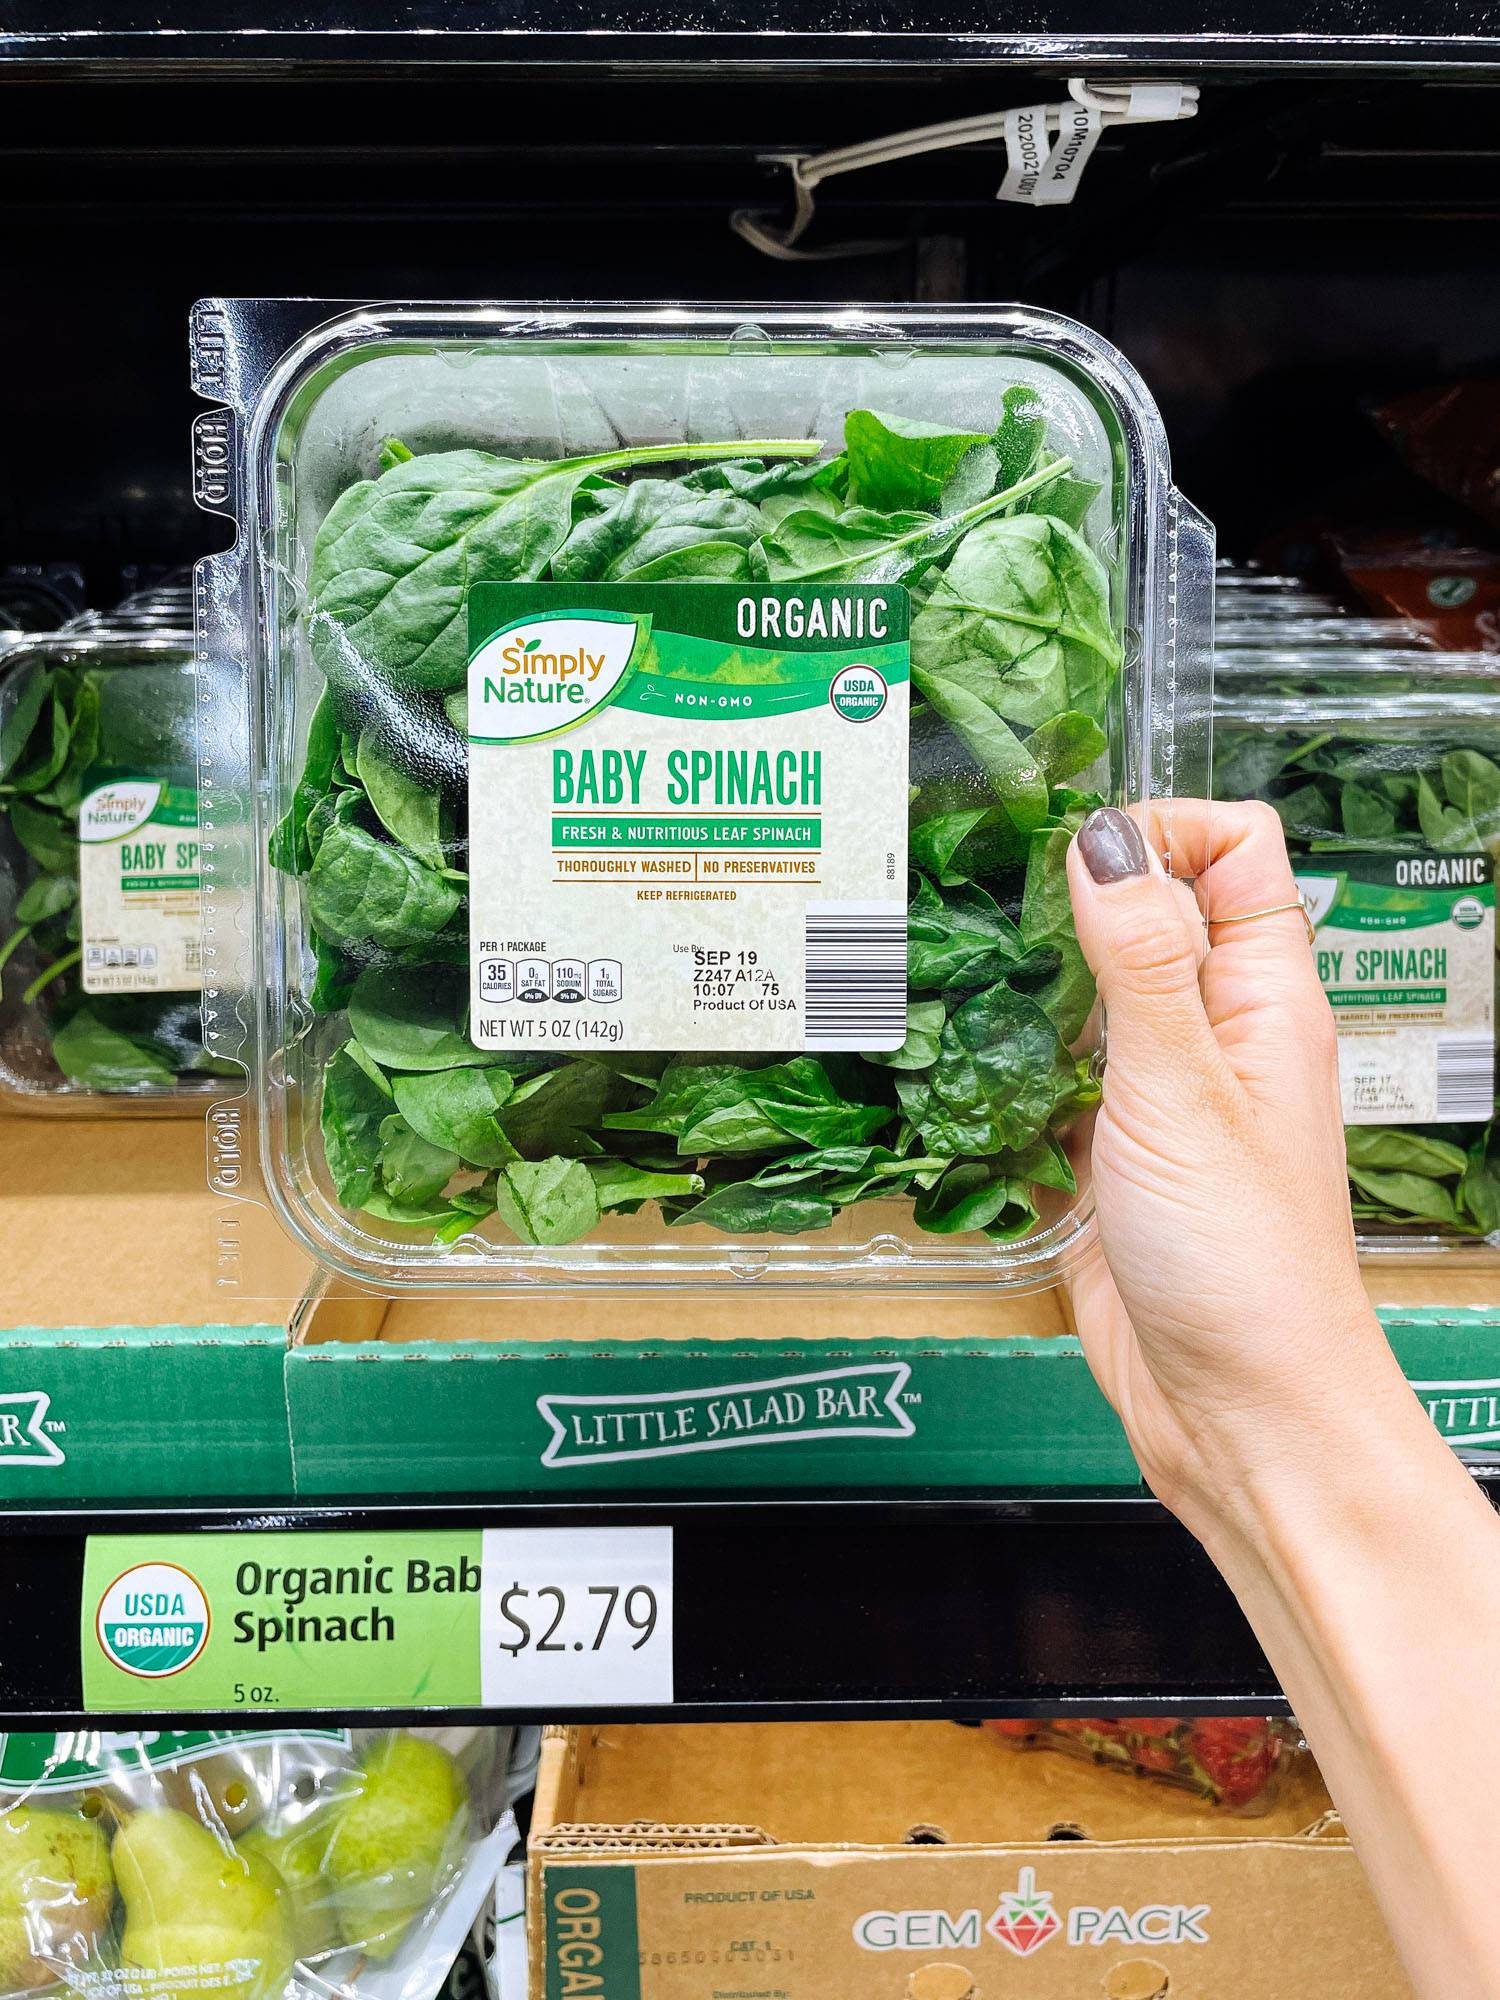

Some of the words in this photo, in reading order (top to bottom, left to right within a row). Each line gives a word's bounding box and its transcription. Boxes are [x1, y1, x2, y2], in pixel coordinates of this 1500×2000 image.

[1051, 107, 1089, 180] 10M10704
[736, 597, 888, 639] ORGANIC
[502, 647, 606, 682] Simply
[843, 679, 875, 693] USDA
[674, 693, 754, 708] NON-GMO
[839, 695, 879, 708] ORGANIC
[552, 749, 647, 806] BABY
[667, 749, 822, 806] SPINACH
[562, 827, 607, 841] FRESH
[611, 827, 622, 840] &
[627, 826, 709, 841] NUTRITIOUS
[713, 826, 749, 841] LEAF
[753, 826, 811, 841] SPINACH
[120, 844, 167, 871] BABY
[557, 859, 637, 874] THOROUGHLY
[641, 859, 691, 874] WASHED
[703, 859, 721, 874] NO
[724, 859, 816, 874] PRESERVATIVES
[887, 852, 895, 880] 88189
[1396, 857, 1486, 887] ORGANIC
[636, 890, 663, 901] KEEP
[665, 890, 737, 901] REFRIGERATED
[479, 941, 498, 952] PER
[500, 941, 505, 952] 1
[507, 941, 547, 952] PACKAGE
[673, 944, 689, 953] Use
[694, 950, 731, 966] SEP
[737, 950, 758, 966] 19
[1355, 948, 1447, 982] SPINACH
[487, 964, 507, 981] 35
[693, 969, 732, 982] Z247
[735, 969, 776, 982] A12A
[482, 982, 512, 990] CALORIES
[521, 980, 533, 988] SAT
[534, 980, 546, 988] FAT
[556, 980, 582, 988] SODIUM
[596, 980, 614, 988] TOTAL
[693, 983, 735, 996] 10:07
[762, 983, 780, 996] 75
[592, 989, 618, 997] SUGARS
[693, 999, 745, 1011] Product
[749, 999, 765, 1011] Of
[768, 999, 797, 1011] USA
[479, 1020, 507, 1038] NET
[510, 1020, 535, 1038] WT
[538, 1020, 547, 1038] 5
[551, 1020, 571, 1038] OZ
[575, 1020, 624, 1042] (142g)
[571, 1407, 698, 1446] LITTLE
[706, 1392, 806, 1438] SALAD
[815, 1385, 884, 1419] BAR
[236, 1555, 393, 1607] Organic
[123, 1593, 186, 1617] USDA
[498, 1581, 659, 1657] $2.79
[113, 1624, 195, 1649] ORGANIC
[233, 1606, 395, 1655] Spinach
[233, 1683, 246, 1703] 5
[250, 1687, 280, 1703] oz.
[684, 1891, 757, 1904] PRODUCT
[759, 1890, 779, 1901] OF
[785, 1888, 816, 1901] USA
[860, 1913, 979, 1948] GEM
[1074, 1908, 1208, 1943] PACK
[553, 1887, 606, 2000] ORGA
